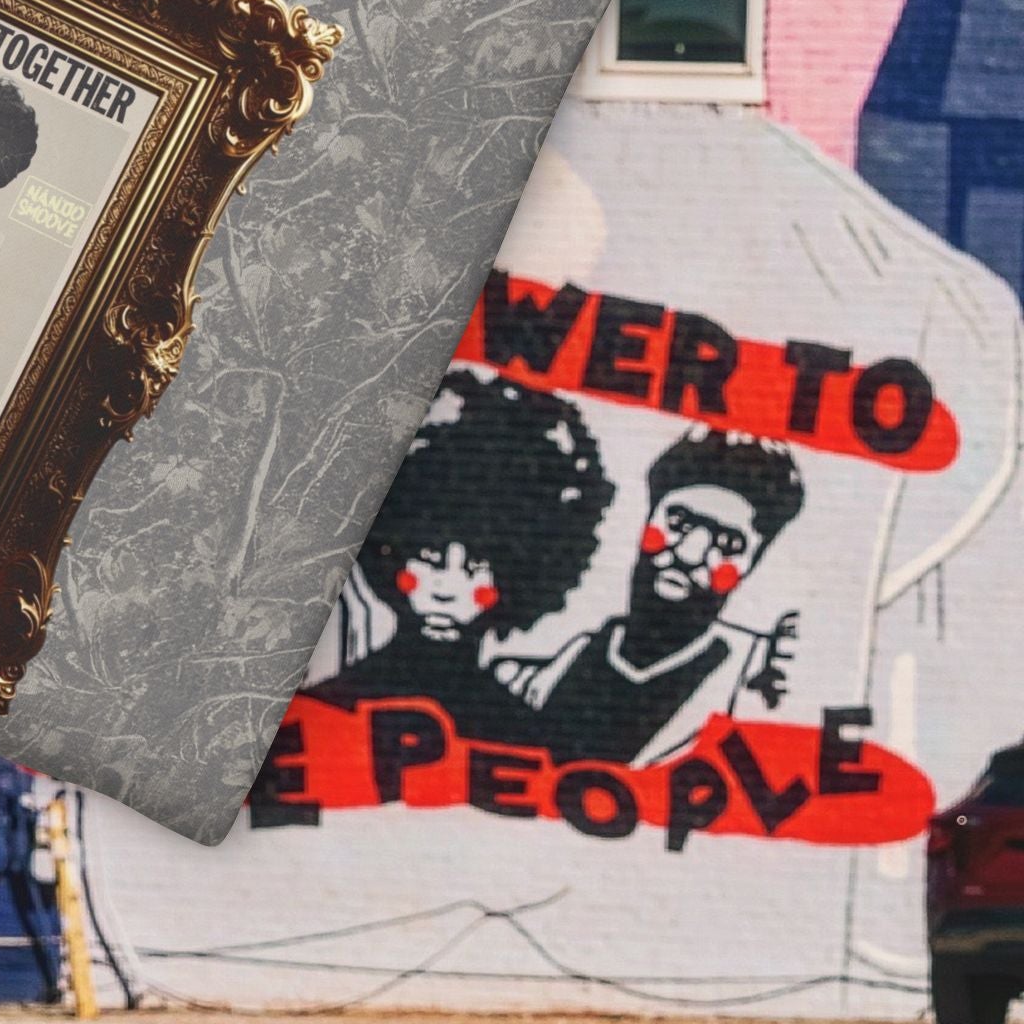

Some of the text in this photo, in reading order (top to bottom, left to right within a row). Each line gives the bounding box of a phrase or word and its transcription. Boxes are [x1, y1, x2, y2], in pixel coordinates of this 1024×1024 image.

[17, 197, 78, 238] SMOOVE
[27, 184, 85, 222] NANDO
[784, 341, 933, 455] TO
[367, 707, 882, 852] PEOPLE
